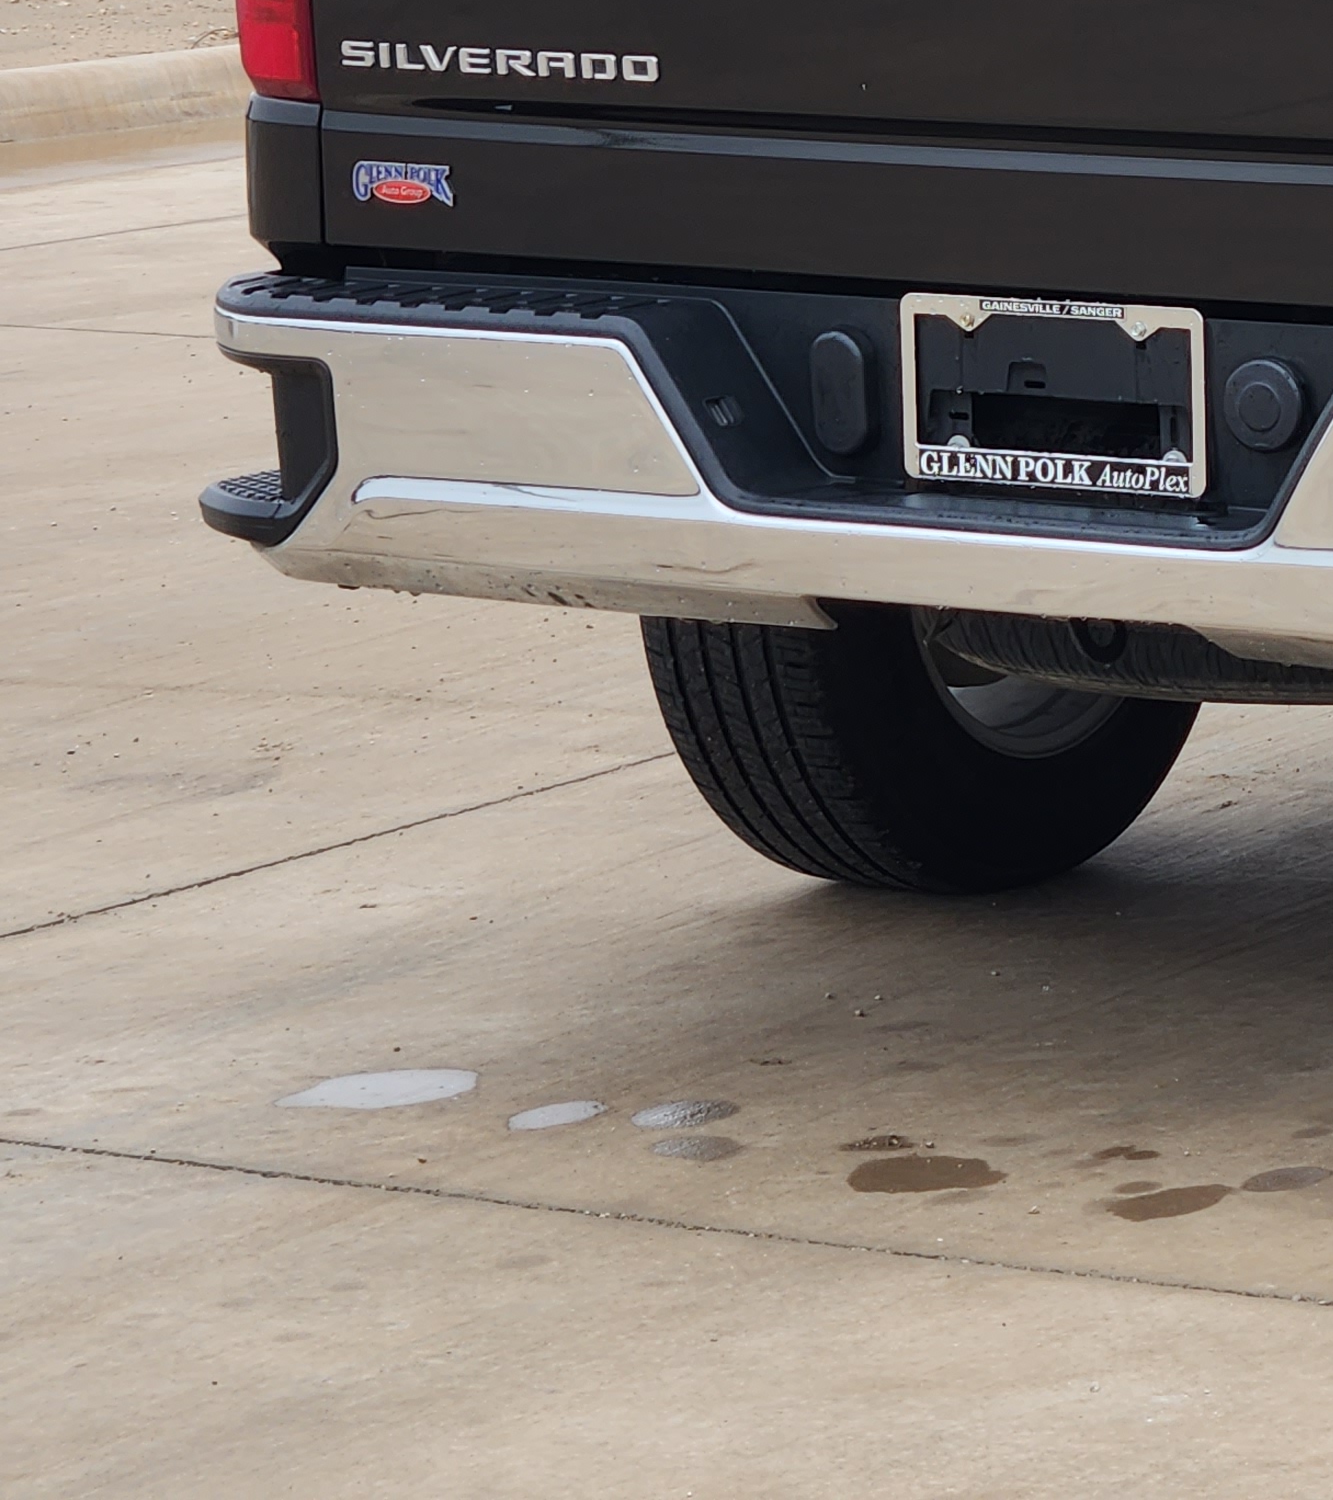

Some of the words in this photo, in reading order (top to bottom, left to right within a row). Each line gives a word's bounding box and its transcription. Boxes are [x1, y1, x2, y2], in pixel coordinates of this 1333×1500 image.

[340, 39, 660, 83] SILVERADO
[353, 161, 405, 199] GLENN
[408, 164, 453, 205] POLK
[981, 300, 1061, 314] GAINESVILLE
[1070, 306, 1123, 318] SANGER
[919, 451, 1013, 479] GLENN
[1016, 456, 1093, 486] POLK
[1096, 466, 1189, 492] AutoPlex
